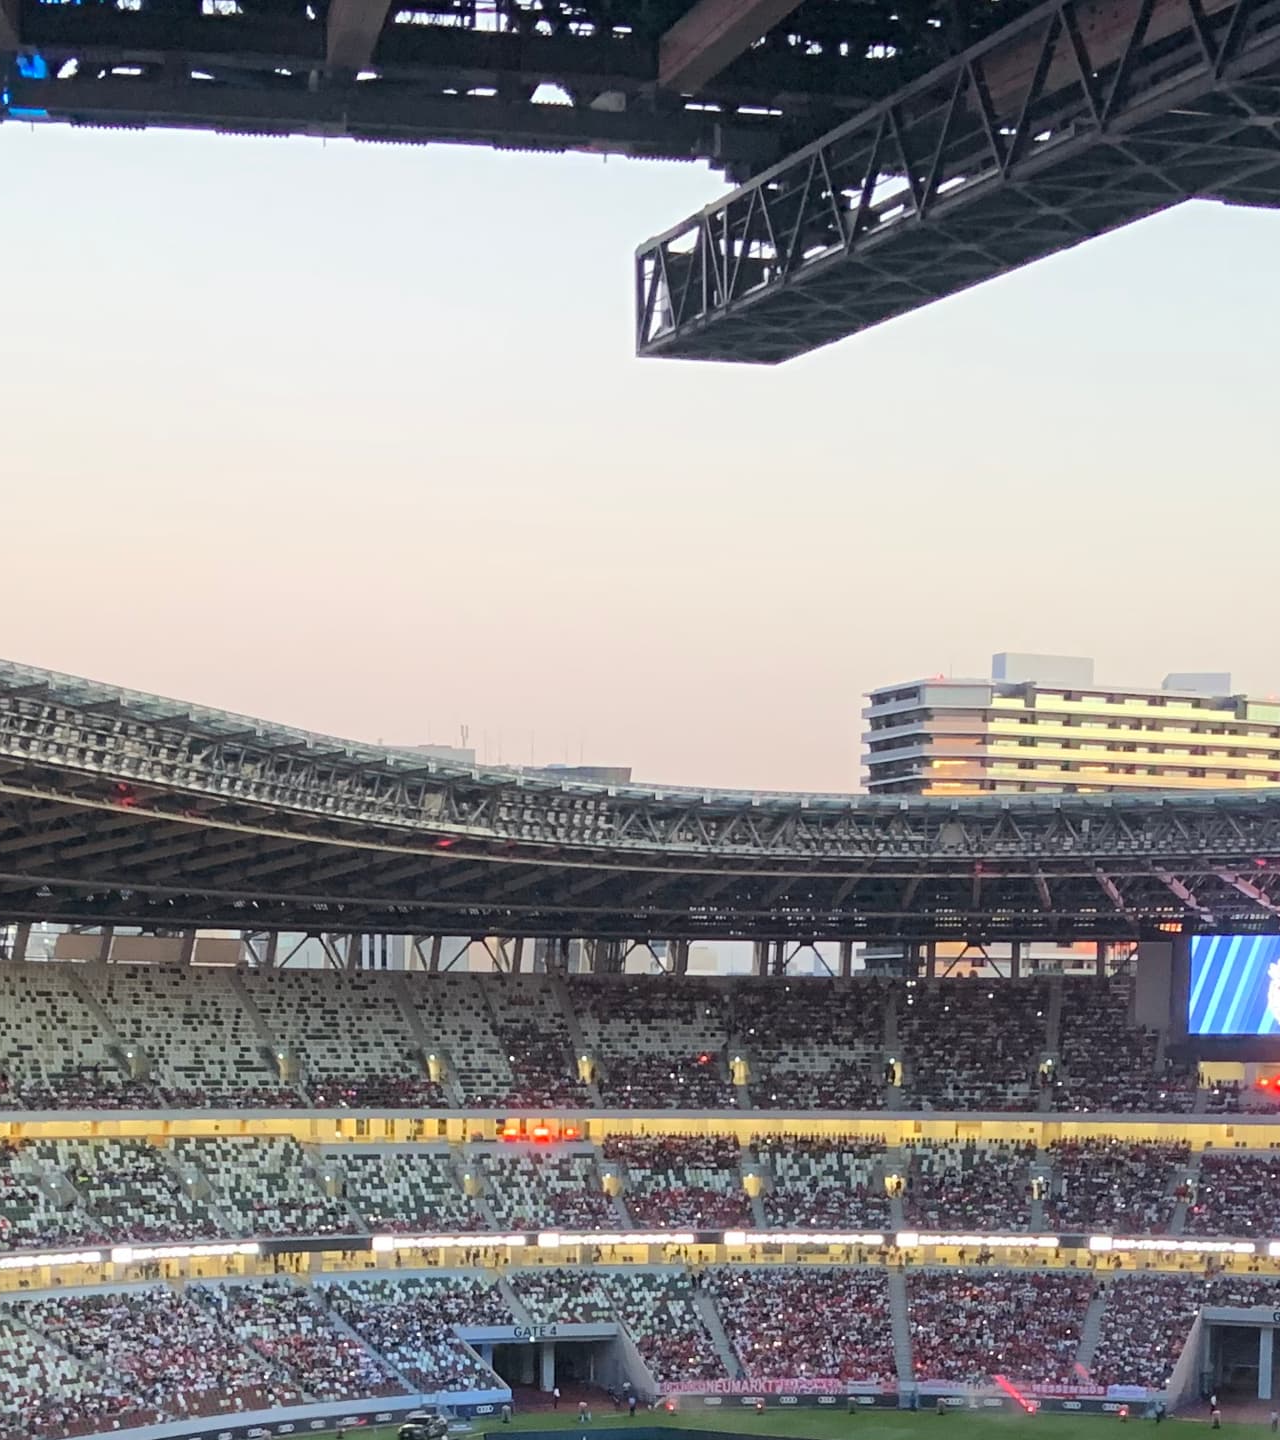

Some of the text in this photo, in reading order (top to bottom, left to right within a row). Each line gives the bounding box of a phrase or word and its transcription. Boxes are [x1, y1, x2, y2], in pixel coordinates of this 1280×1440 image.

[513, 1326, 557, 1338] GATE 4
[706, 1378, 774, 1393] NEUMARKT
